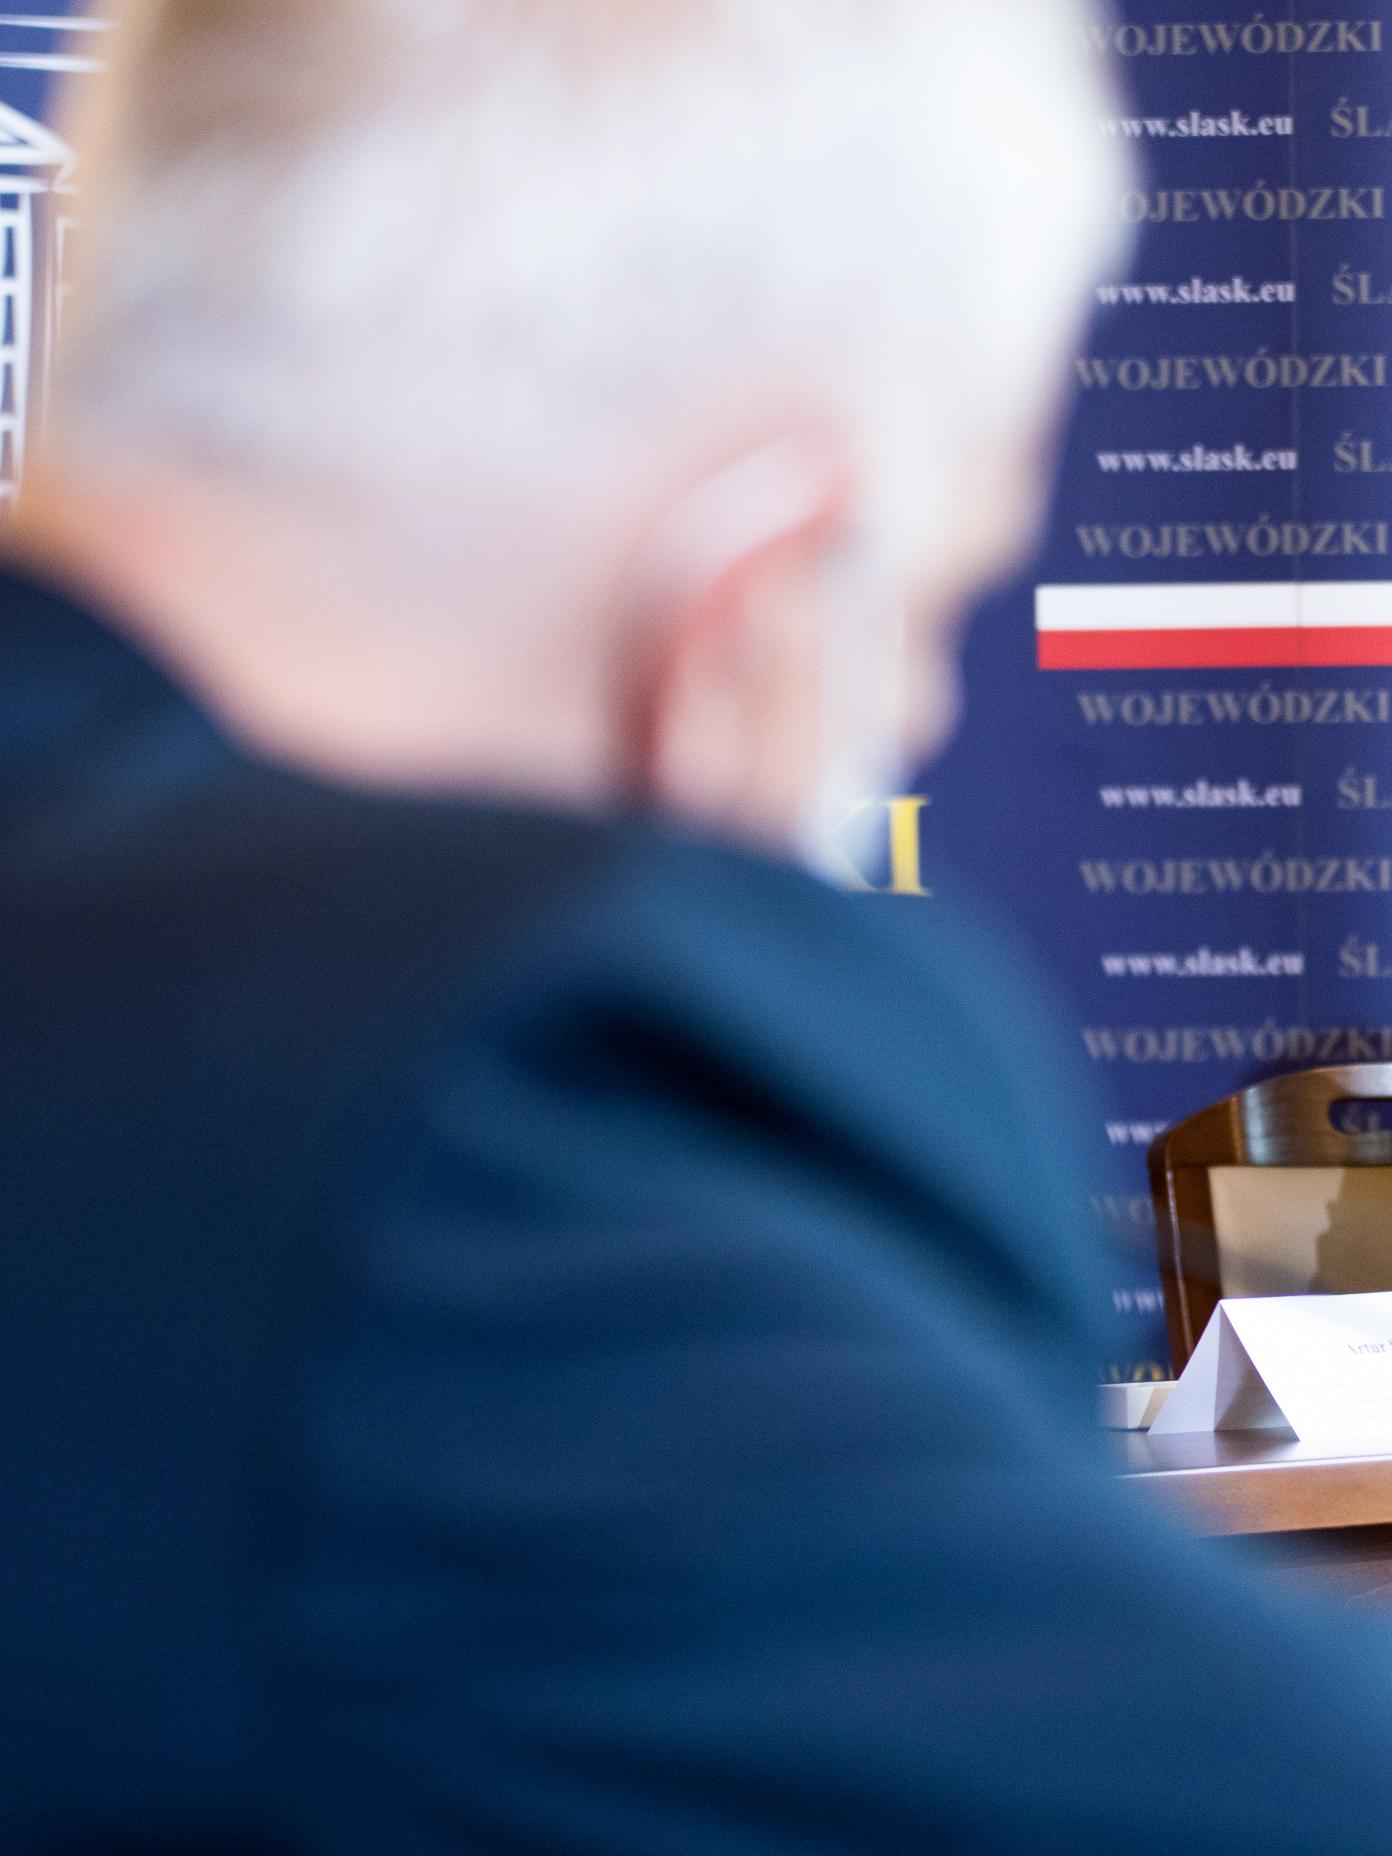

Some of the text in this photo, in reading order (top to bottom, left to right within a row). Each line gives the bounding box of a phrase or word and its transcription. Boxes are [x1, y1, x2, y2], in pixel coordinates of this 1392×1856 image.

[1100, 109, 1294, 138] www.slask.eu
[1124, 181, 1386, 222] OJEWÓDZKI
[1097, 276, 1296, 304] www.slask.eu
[1075, 347, 1388, 390] WOJEWÓDZKI
[1097, 444, 1299, 472] www.slask.eu
[1075, 512, 1390, 558] WOJEWÓDZKI
[1077, 680, 1392, 726] WOJEWÓDZKI
[1100, 780, 1302, 808] www.slask.eu
[1102, 947, 1304, 976] www.slask.eu
